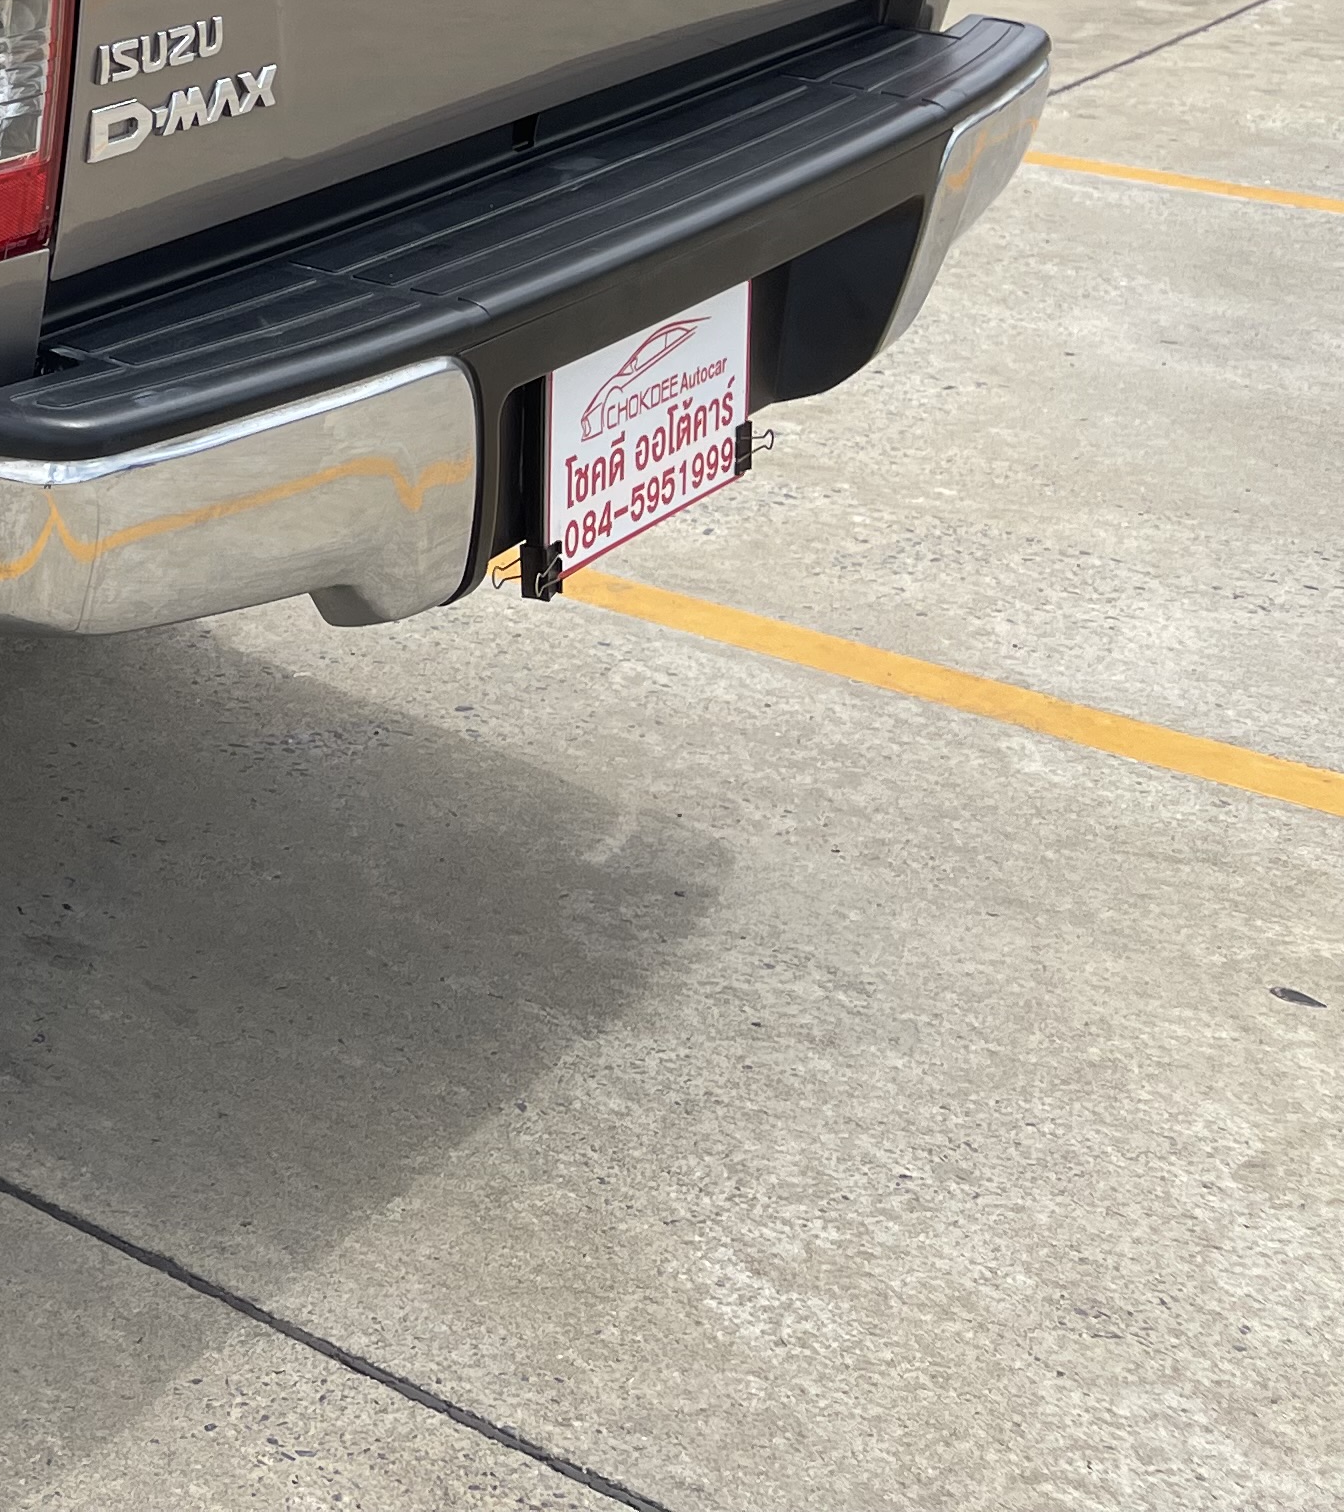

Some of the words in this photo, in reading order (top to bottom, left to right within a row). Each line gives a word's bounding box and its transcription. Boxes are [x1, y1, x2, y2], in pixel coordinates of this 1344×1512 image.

[96, 16, 223, 85] ISUZU
[86, 64, 277, 163] D-MAX
[565, 431, 627, 509] โชคดี
[635, 376, 735, 471] ออโต้คาร์
[607, 374, 678, 429] CHOKDEE
[681, 357, 727, 393] Autocar
[564, 437, 734, 558] 084-5951999
